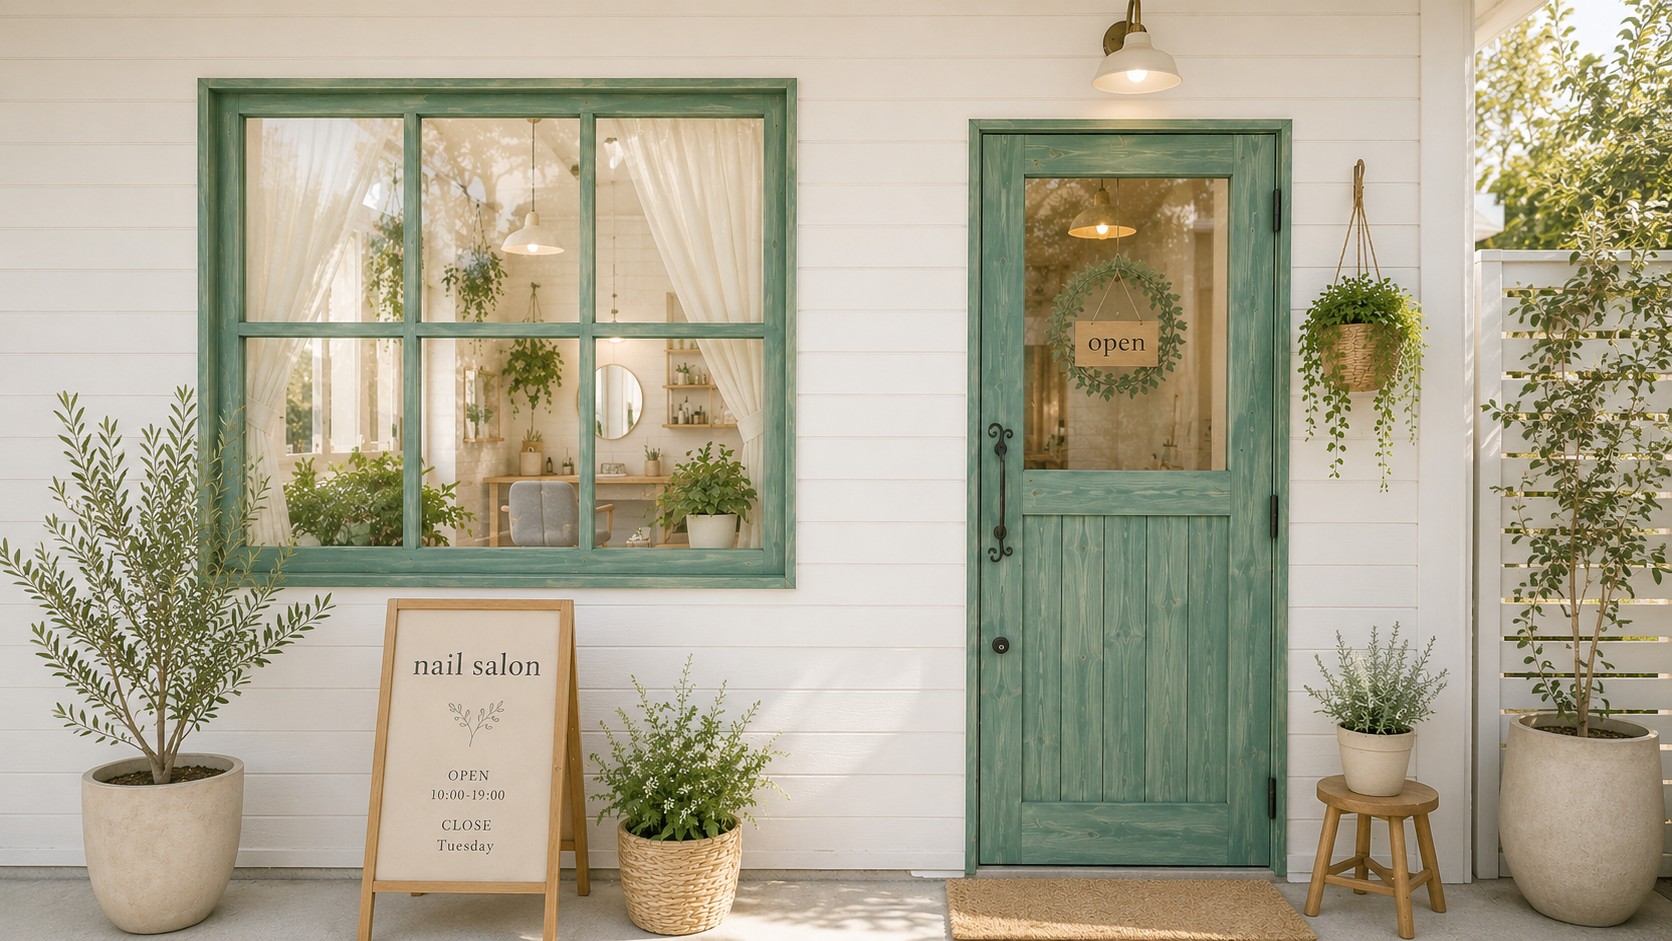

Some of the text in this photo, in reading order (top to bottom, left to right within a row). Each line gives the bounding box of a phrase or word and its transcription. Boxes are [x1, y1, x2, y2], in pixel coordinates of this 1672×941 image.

[1088, 337, 1146, 357] open
[412, 652, 541, 676] nail salon
[447, 769, 490, 782] OPEN
[431, 789, 506, 801] 10:00-19:00
[441, 819, 492, 832] CLOSE
[436, 839, 495, 856] Tuesday
